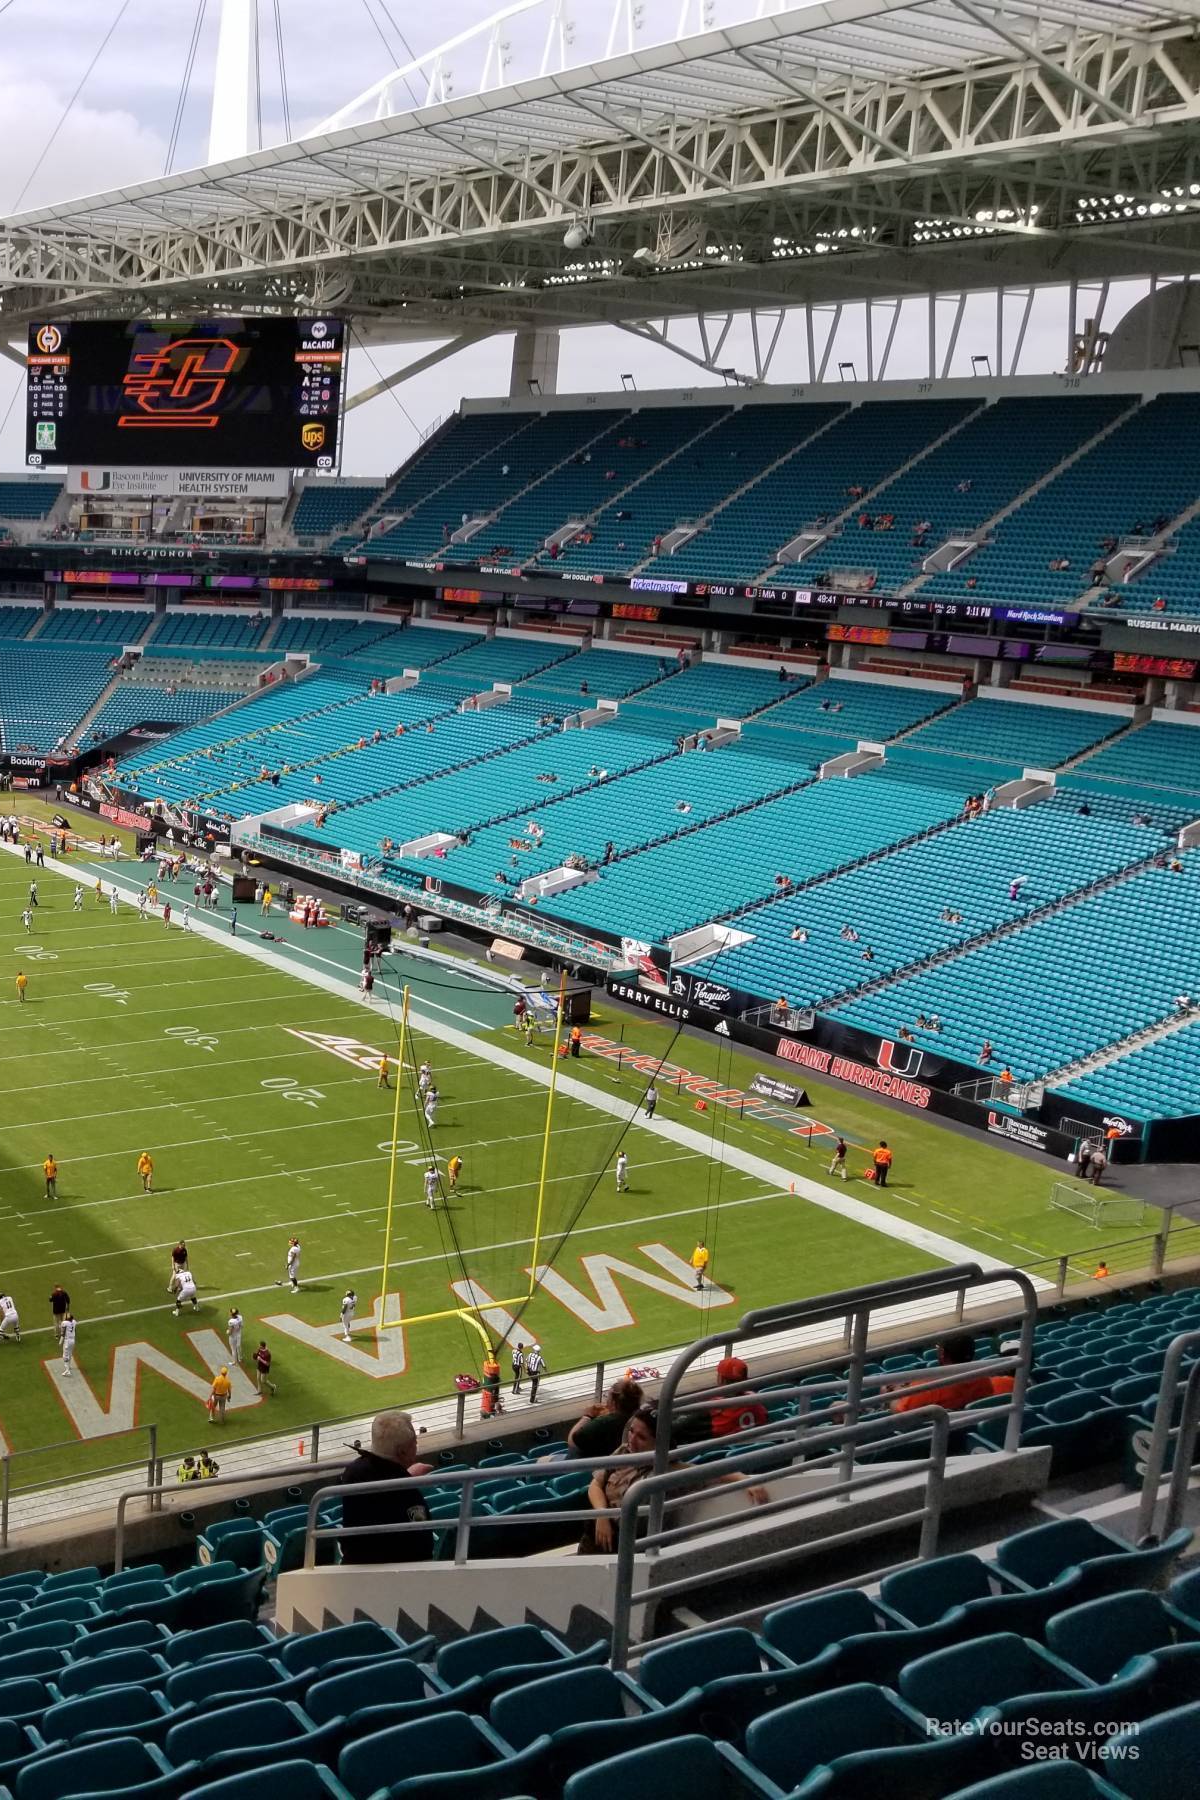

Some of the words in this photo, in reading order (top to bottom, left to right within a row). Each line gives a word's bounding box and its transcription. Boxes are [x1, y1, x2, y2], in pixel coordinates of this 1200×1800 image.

[302, 339, 335, 350] BACARDÍ
[29, 455, 41, 464] CC
[318, 457, 331, 466] CC
[112, 471, 141, 481] Bascom
[142, 471, 169, 482] Palmer
[179, 472, 231, 482] UNIVERSITY
[232, 473, 244, 482] OF
[245, 473, 275, 482] MIAMI
[112, 481, 125, 491] Eye
[126, 481, 157, 490] Institute
[179, 483, 212, 493] HEALTH
[213, 484, 248, 493] SYSTEM
[494, 567, 512, 575] TAYLOR
[573, 574, 593, 582] DOOLEY
[632, 579, 682, 592] ticketmaster
[710, 585, 727, 595] CMU
[729, 587, 735, 595] 0
[762, 590, 776, 599] MIA
[781, 592, 787, 600] 0
[816, 594, 837, 604] 49:41
[903, 602, 912, 610] 10
[946, 606, 956, 614] 25
[980, 607, 991, 617] PM
[1007, 609, 1022, 619] Hard
[1022, 611, 1037, 621] Rock
[1037, 613, 1063, 623] Stadium
[1127, 619, 1169, 630] RUSSELL
[1170, 622, 1200, 633] MARY
[10, 756, 46, 768] Booking
[14, 945, 60, 960] 50
[694, 982, 731, 1003] Penguin
[612, 983, 650, 1005] PERRY
[655, 998, 689, 1019] ELLIS
[164, 1026, 220, 1047] 30
[776, 1038, 832, 1073] MIAMI
[831, 1056, 932, 1109] HURRICANES
[260, 1077, 327, 1102] 20
[377, 1140, 448, 1166] 10
